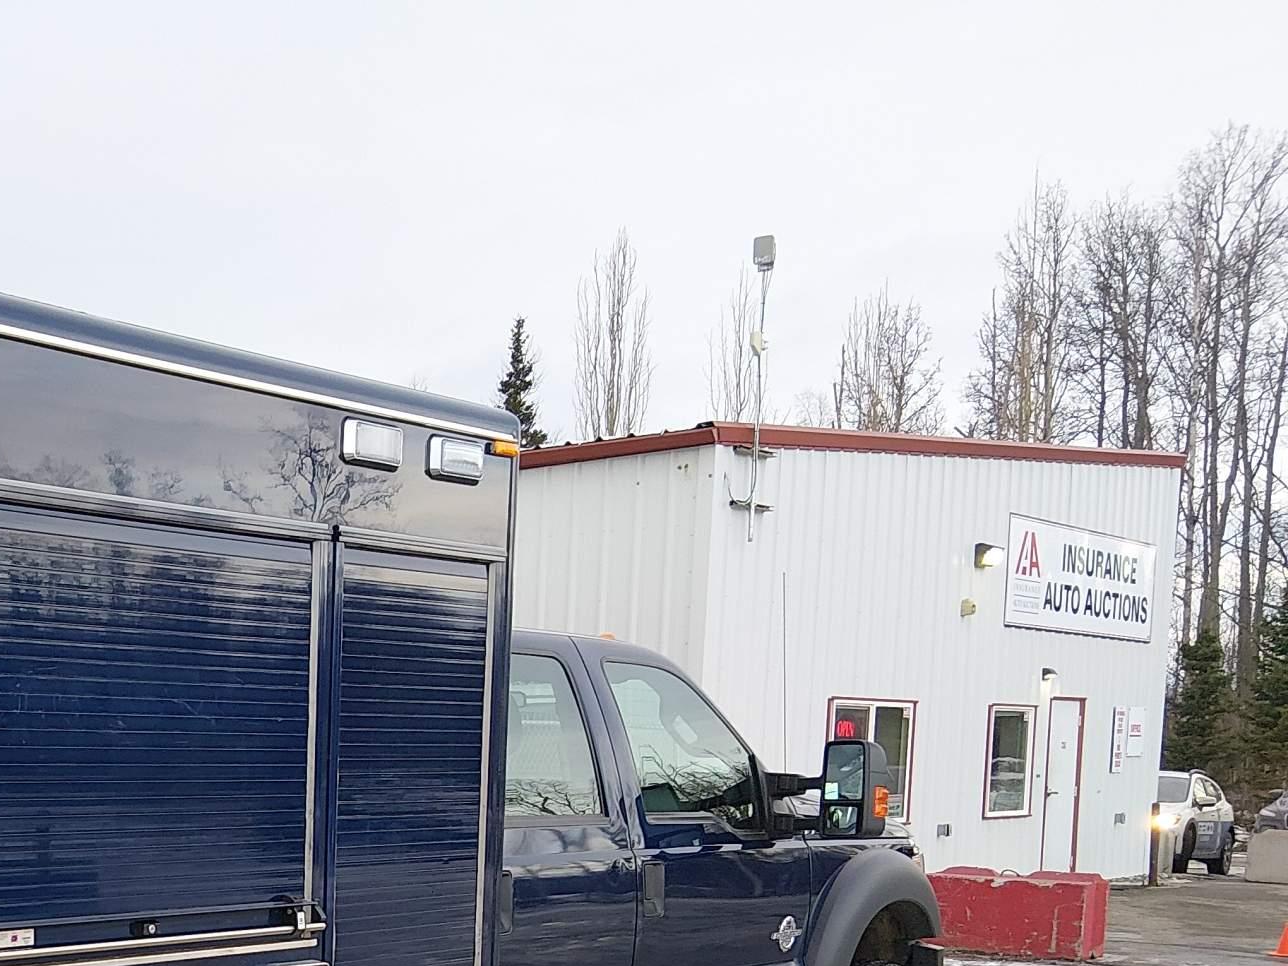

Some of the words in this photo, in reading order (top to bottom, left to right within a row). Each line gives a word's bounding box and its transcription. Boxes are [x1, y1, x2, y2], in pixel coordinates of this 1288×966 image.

[1062, 543, 1138, 585] INSURANCE
[1043, 581, 1081, 615] AUTO
[1083, 588, 1149, 625] AUCTIONS
[836, 719, 856, 737] OPEN
